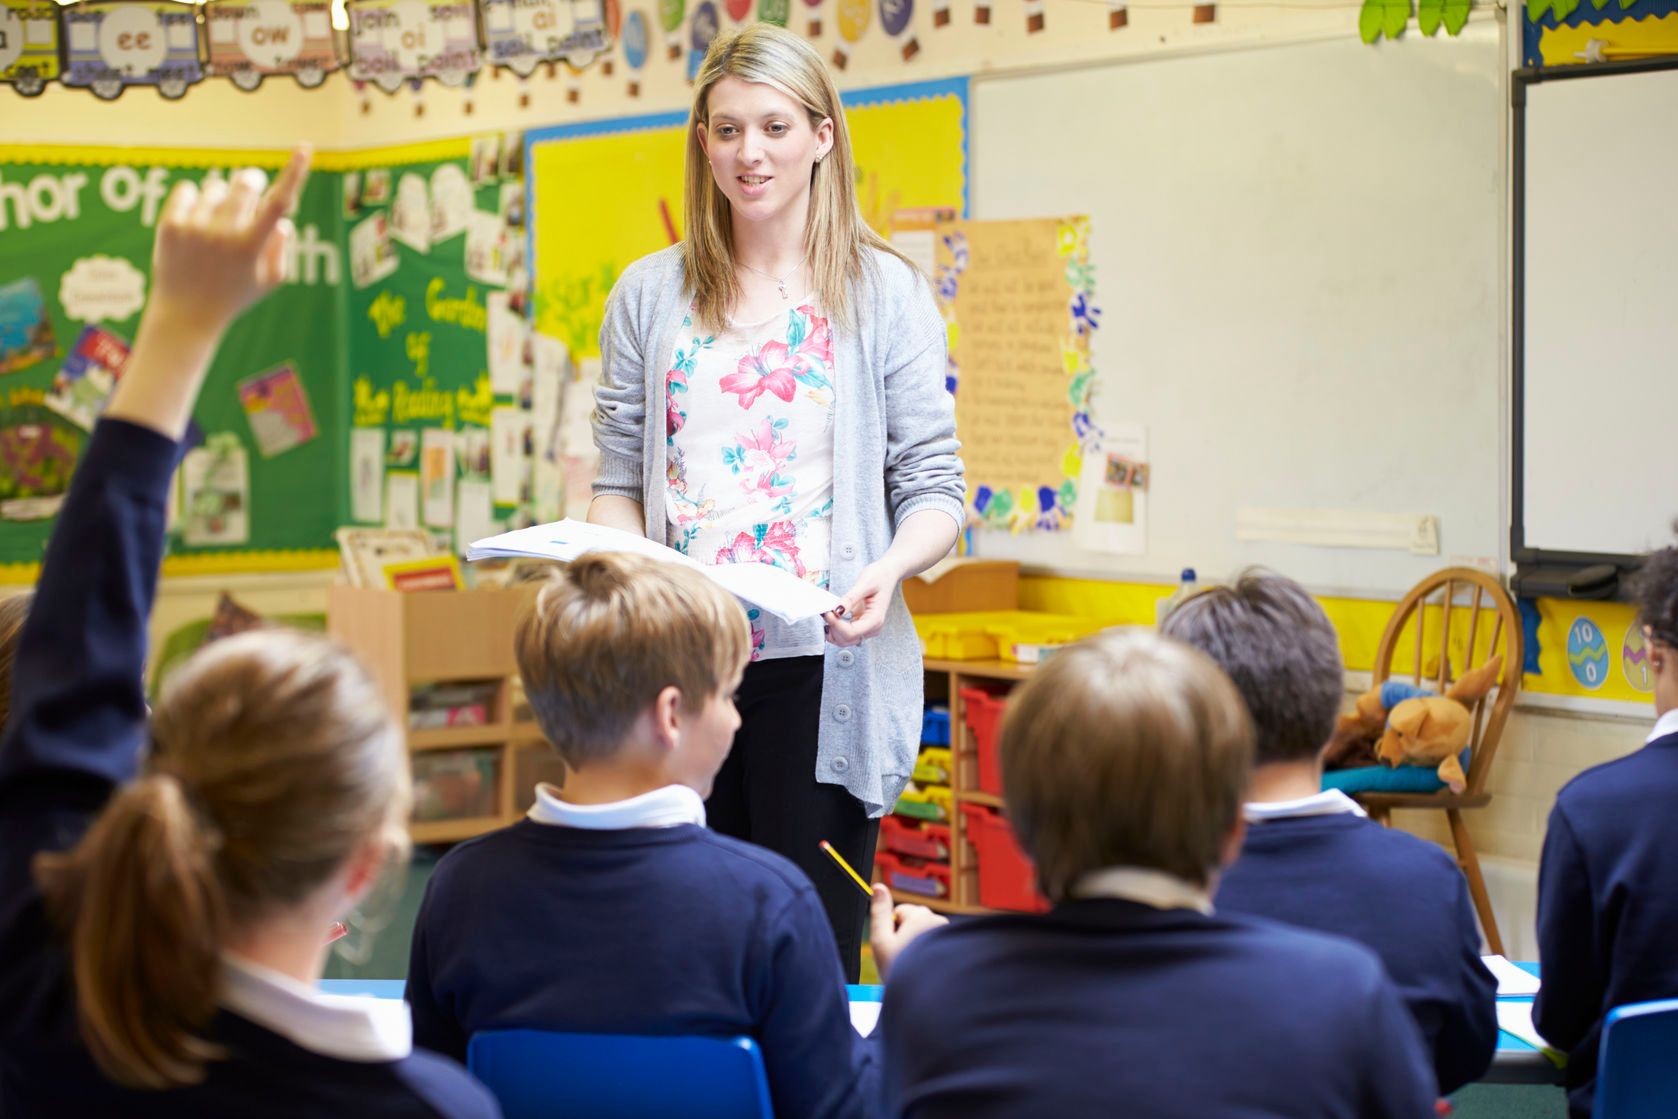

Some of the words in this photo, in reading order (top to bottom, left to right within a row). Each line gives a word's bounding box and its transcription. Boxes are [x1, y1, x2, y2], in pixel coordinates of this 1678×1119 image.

[117, 31, 151, 51] ee
[251, 27, 291, 46] ow
[400, 22, 427, 50] oi
[417, 47, 477, 74] point
[1573, 623, 1593, 646] 10
[1586, 662, 1597, 683] 0
[1641, 664, 1648, 688] 1
